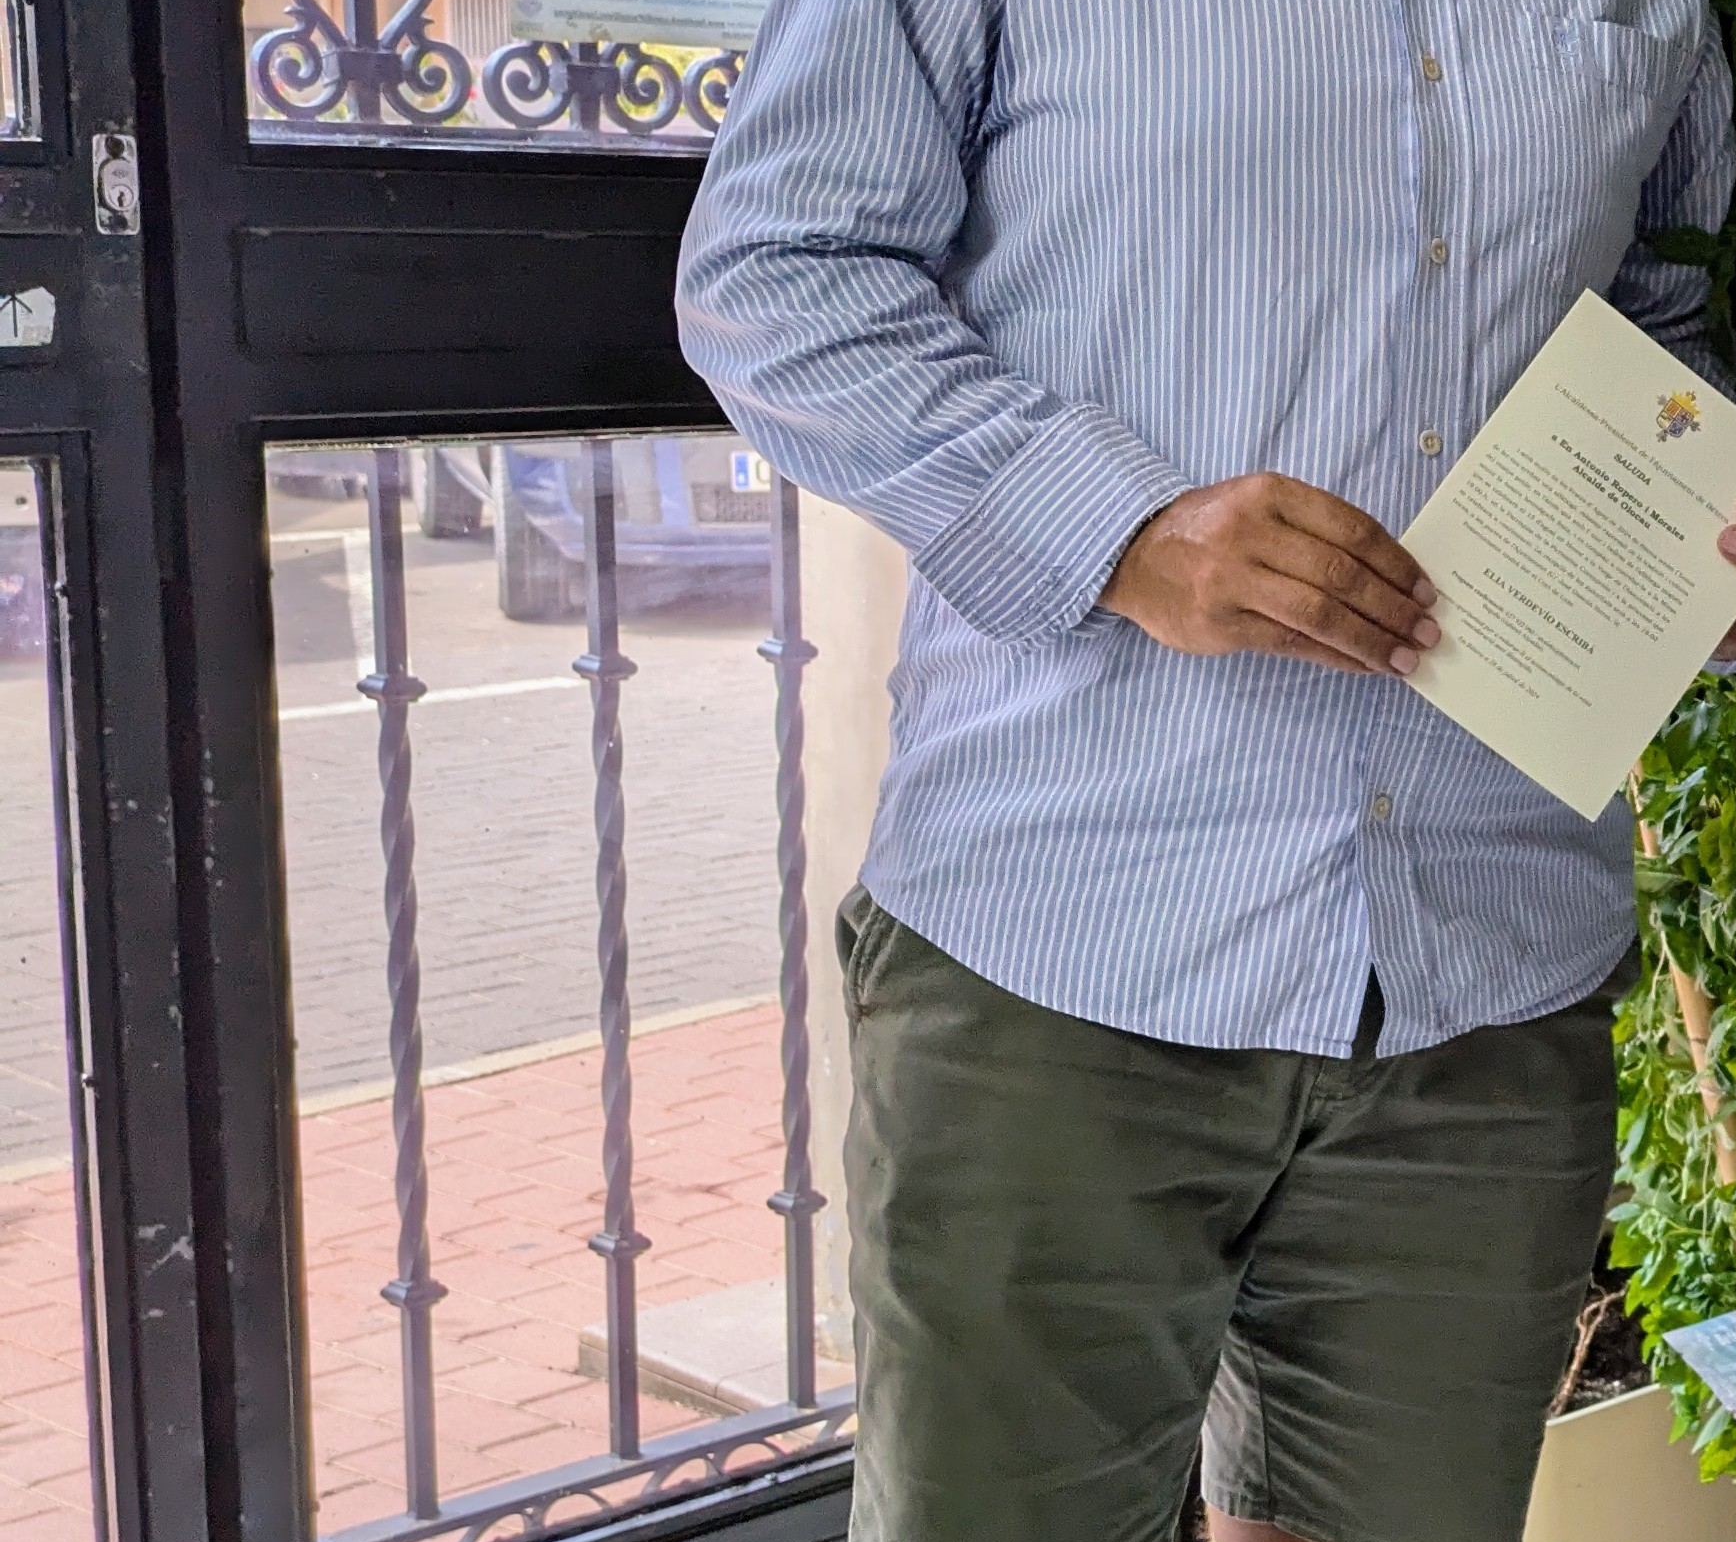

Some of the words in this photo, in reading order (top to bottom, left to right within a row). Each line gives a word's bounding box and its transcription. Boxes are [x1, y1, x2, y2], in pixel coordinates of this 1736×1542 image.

[1558, 438, 1574, 452] En
[1572, 450, 1612, 482] Antonio
[1609, 479, 1645, 509] Ropero
[1648, 509, 1687, 541] Morales
[1570, 464, 1607, 493] Alcalde
[1606, 490, 1620, 503] de
[1618, 500, 1653, 529] Olocau
[1611, 452, 1654, 487] SALUDA
